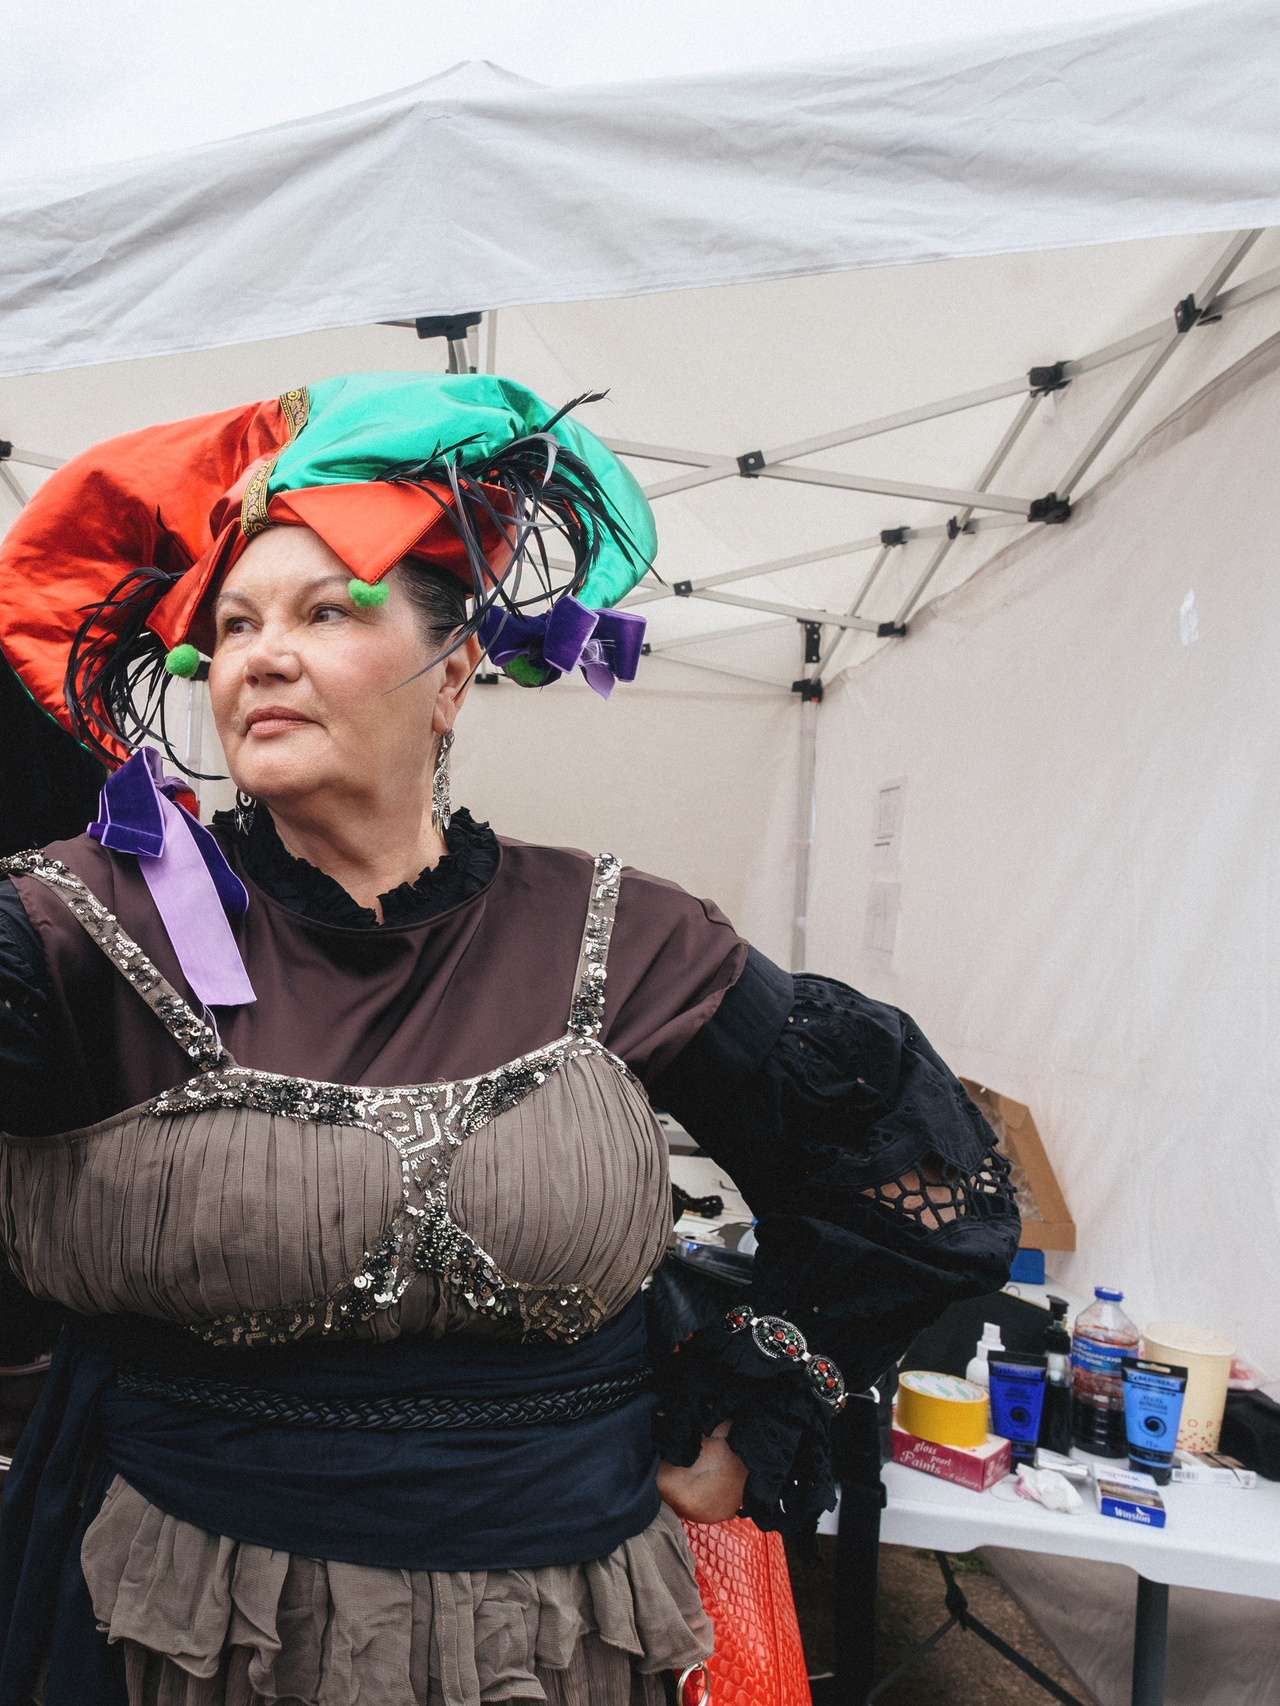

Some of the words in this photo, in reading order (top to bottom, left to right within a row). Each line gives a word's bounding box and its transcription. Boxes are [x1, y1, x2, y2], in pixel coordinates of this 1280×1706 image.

[913, 1441, 938, 1456] gloss
[900, 1450, 941, 1475] Paints
[931, 1455, 952, 1466] pearl
[1114, 1506, 1151, 1524] Winston
